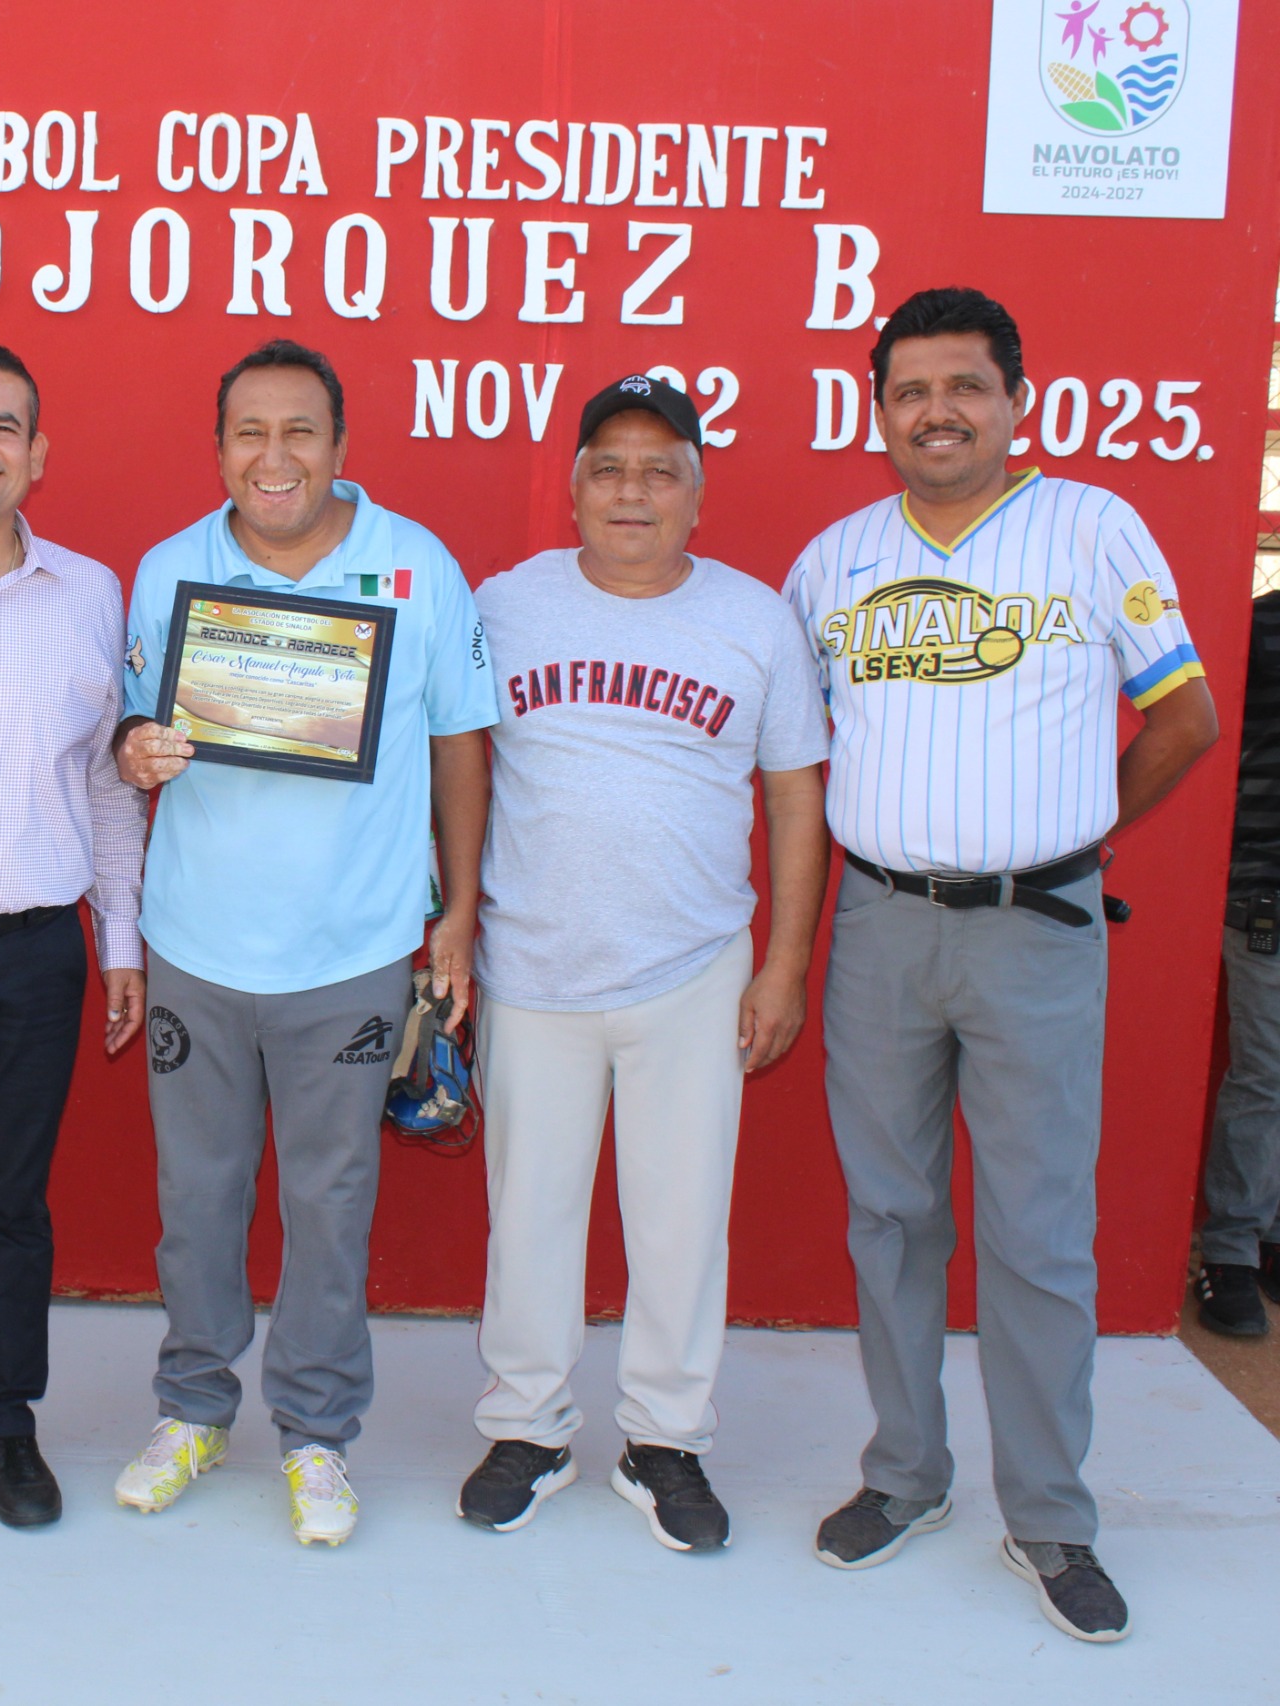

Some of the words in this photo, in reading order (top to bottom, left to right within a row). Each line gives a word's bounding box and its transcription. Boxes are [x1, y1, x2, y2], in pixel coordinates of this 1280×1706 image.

[157, 110, 329, 195] COPA
[374, 115, 827, 210] PRESIDENTE
[1032, 143, 1181, 167] NAVOLATO
[1032, 165, 1049, 177] EL
[1053, 166, 1113, 179] FUTURO
[1143, 168, 1180, 181] HOY!
[1061, 185, 1144, 200] 2024-2027
[410, 358, 564, 442] NOV
[250, 618, 275, 626] ESTADO
[285, 623, 312, 631] SINALOA
[823, 596, 1084, 657] SINALOA
[201, 627, 270, 646] RECONOCE
[288, 639, 357, 658] AGRADECE
[229, 655, 280, 672] Manuel
[281, 662, 325, 679] Angulo
[850, 652, 943, 684] LSEYJ
[508, 662, 562, 717] SAN
[569, 660, 735, 738] FRANCISCO
